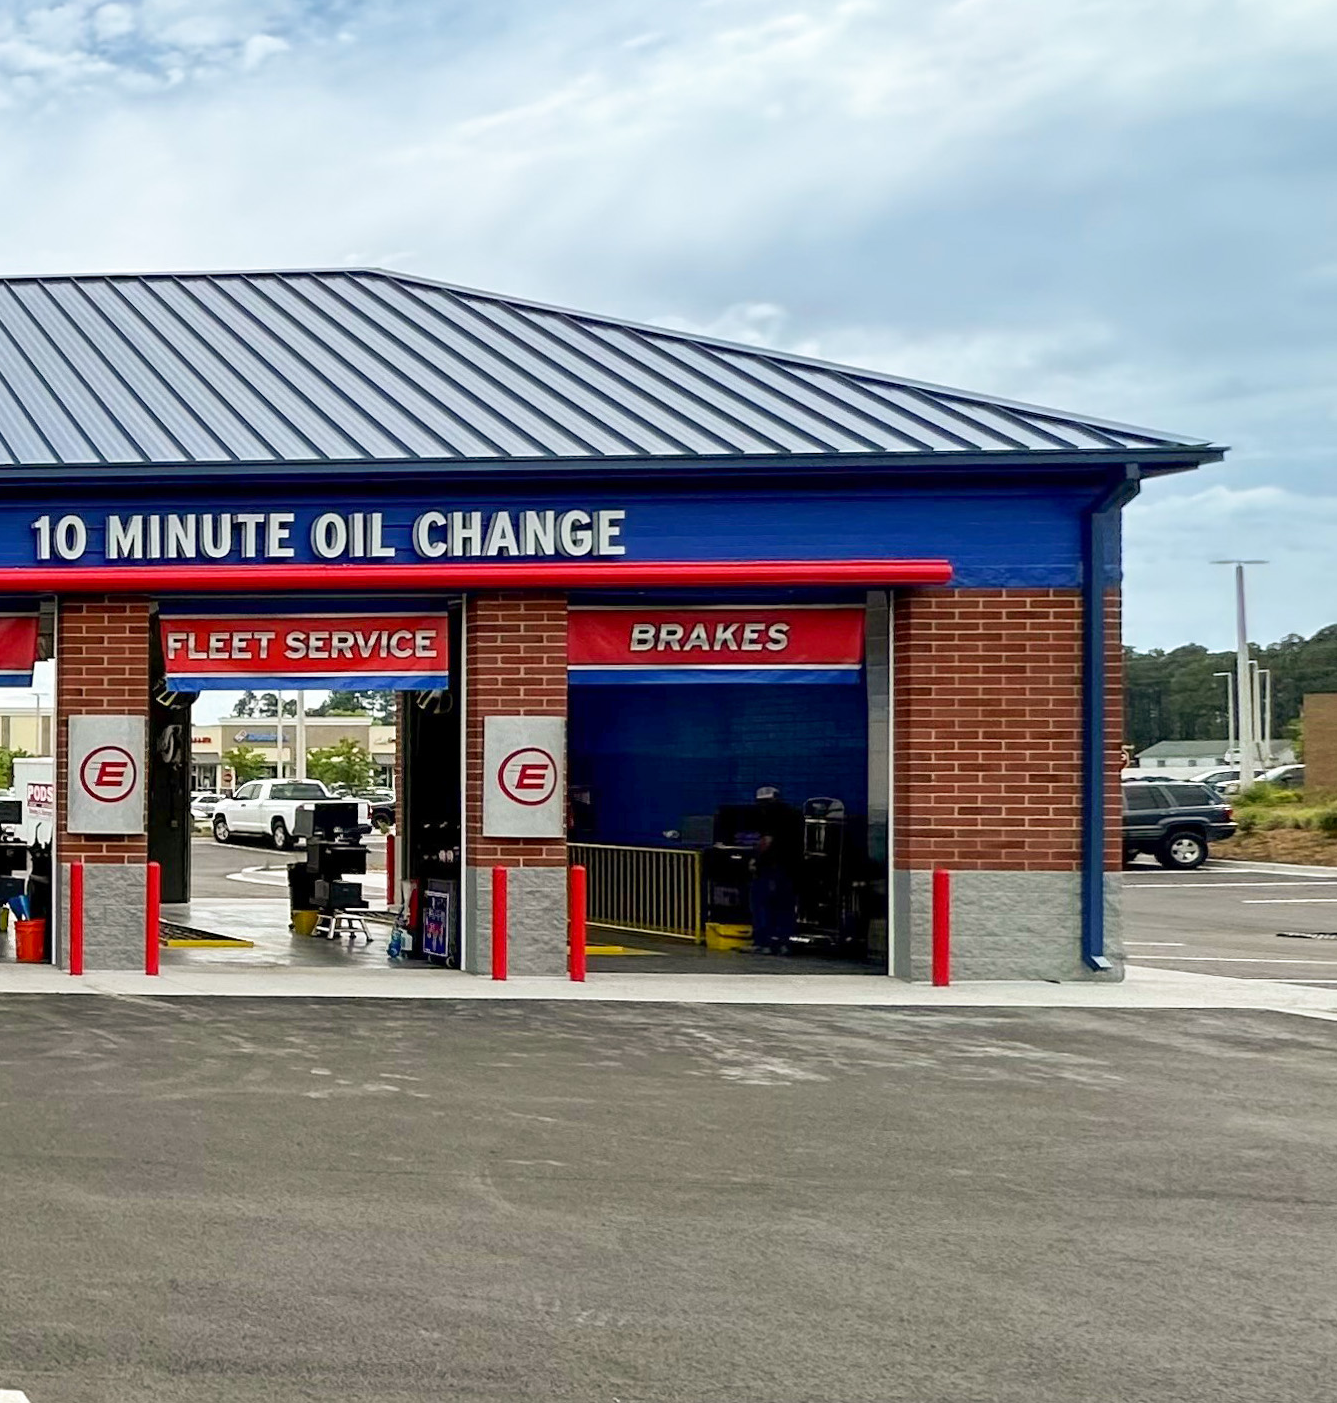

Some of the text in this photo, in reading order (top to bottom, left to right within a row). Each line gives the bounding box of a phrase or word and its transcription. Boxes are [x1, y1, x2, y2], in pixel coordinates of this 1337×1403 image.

[31, 509, 627, 561] 10 MINUTE OIL CHANGE
[167, 629, 438, 660] FLEET SERVICE
[629, 622, 791, 652] BRAKES
[93, 761, 128, 787] E
[514, 763, 549, 790] E
[27, 784, 54, 804] PODS
